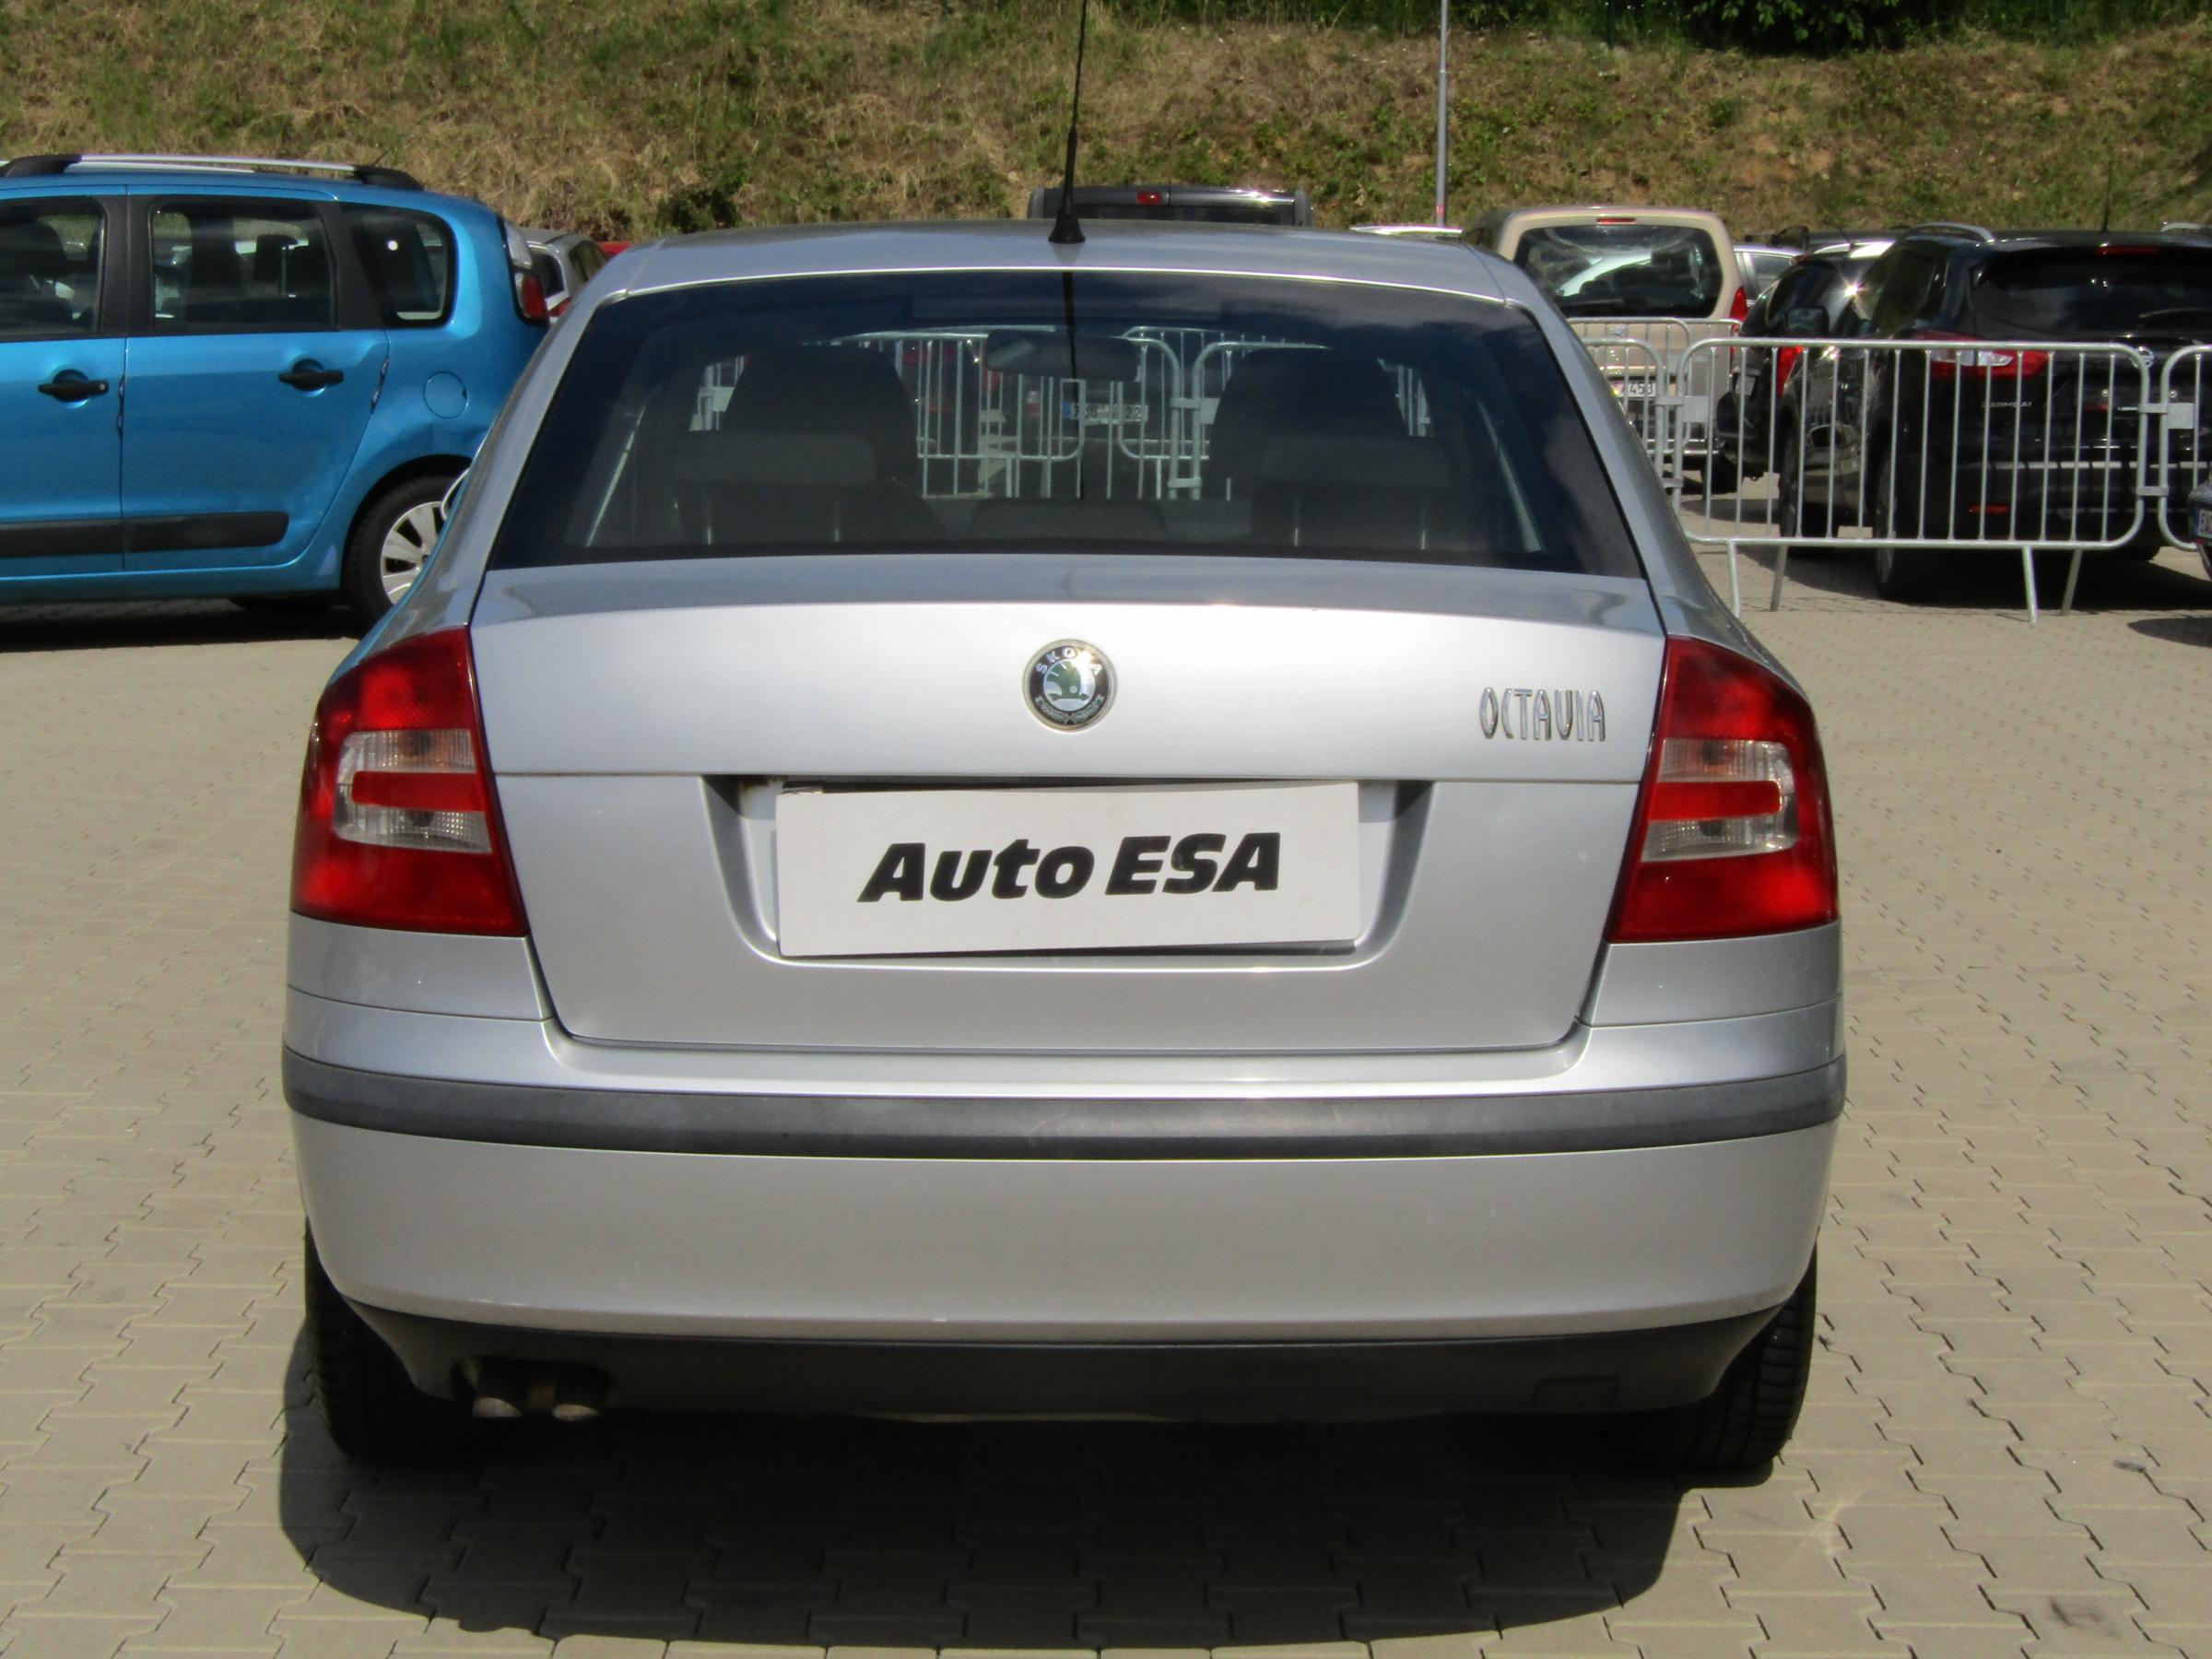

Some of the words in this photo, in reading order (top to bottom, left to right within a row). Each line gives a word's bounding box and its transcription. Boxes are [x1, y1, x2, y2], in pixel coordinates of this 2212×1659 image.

[1035, 646, 1103, 675] SKOA
[1479, 687, 1606, 742] OCTAVIA
[857, 839, 1095, 903] Auto
[1105, 831, 1281, 896] ESA
